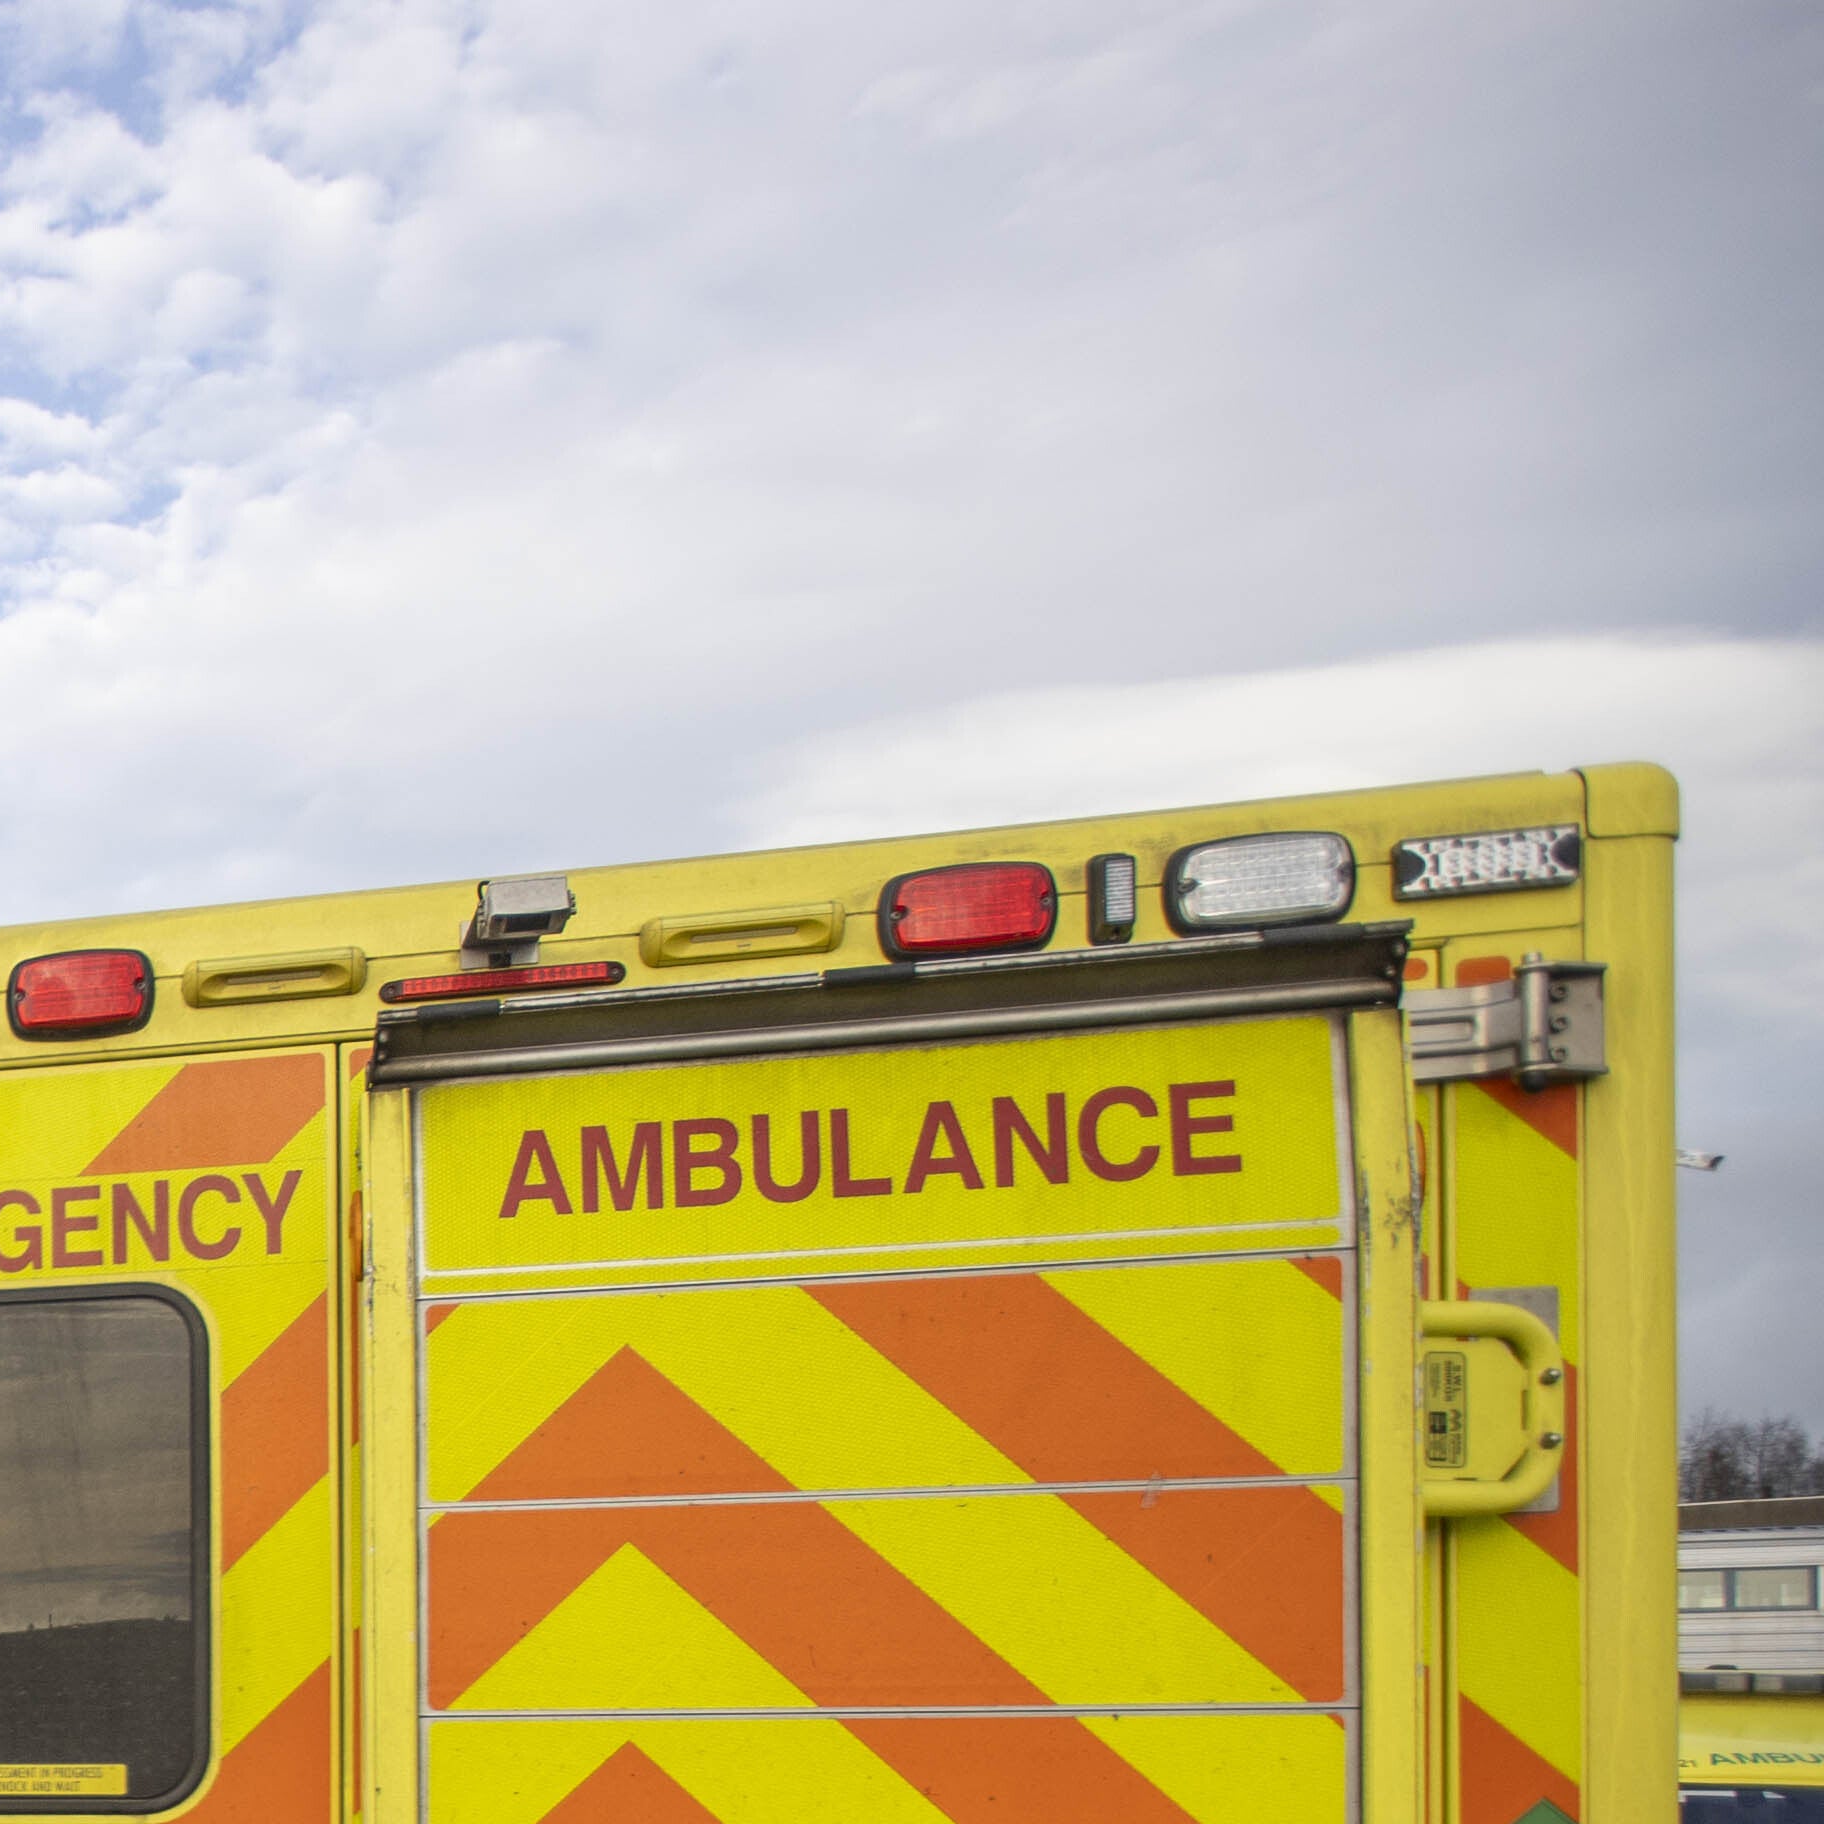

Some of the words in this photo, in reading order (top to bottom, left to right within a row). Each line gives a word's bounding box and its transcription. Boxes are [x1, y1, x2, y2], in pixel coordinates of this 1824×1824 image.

[498, 1080, 1243, 1218] AMBULANCE
[32, 1781, 52, 1792] AND
[55, 1781, 80, 1792] WAIT
